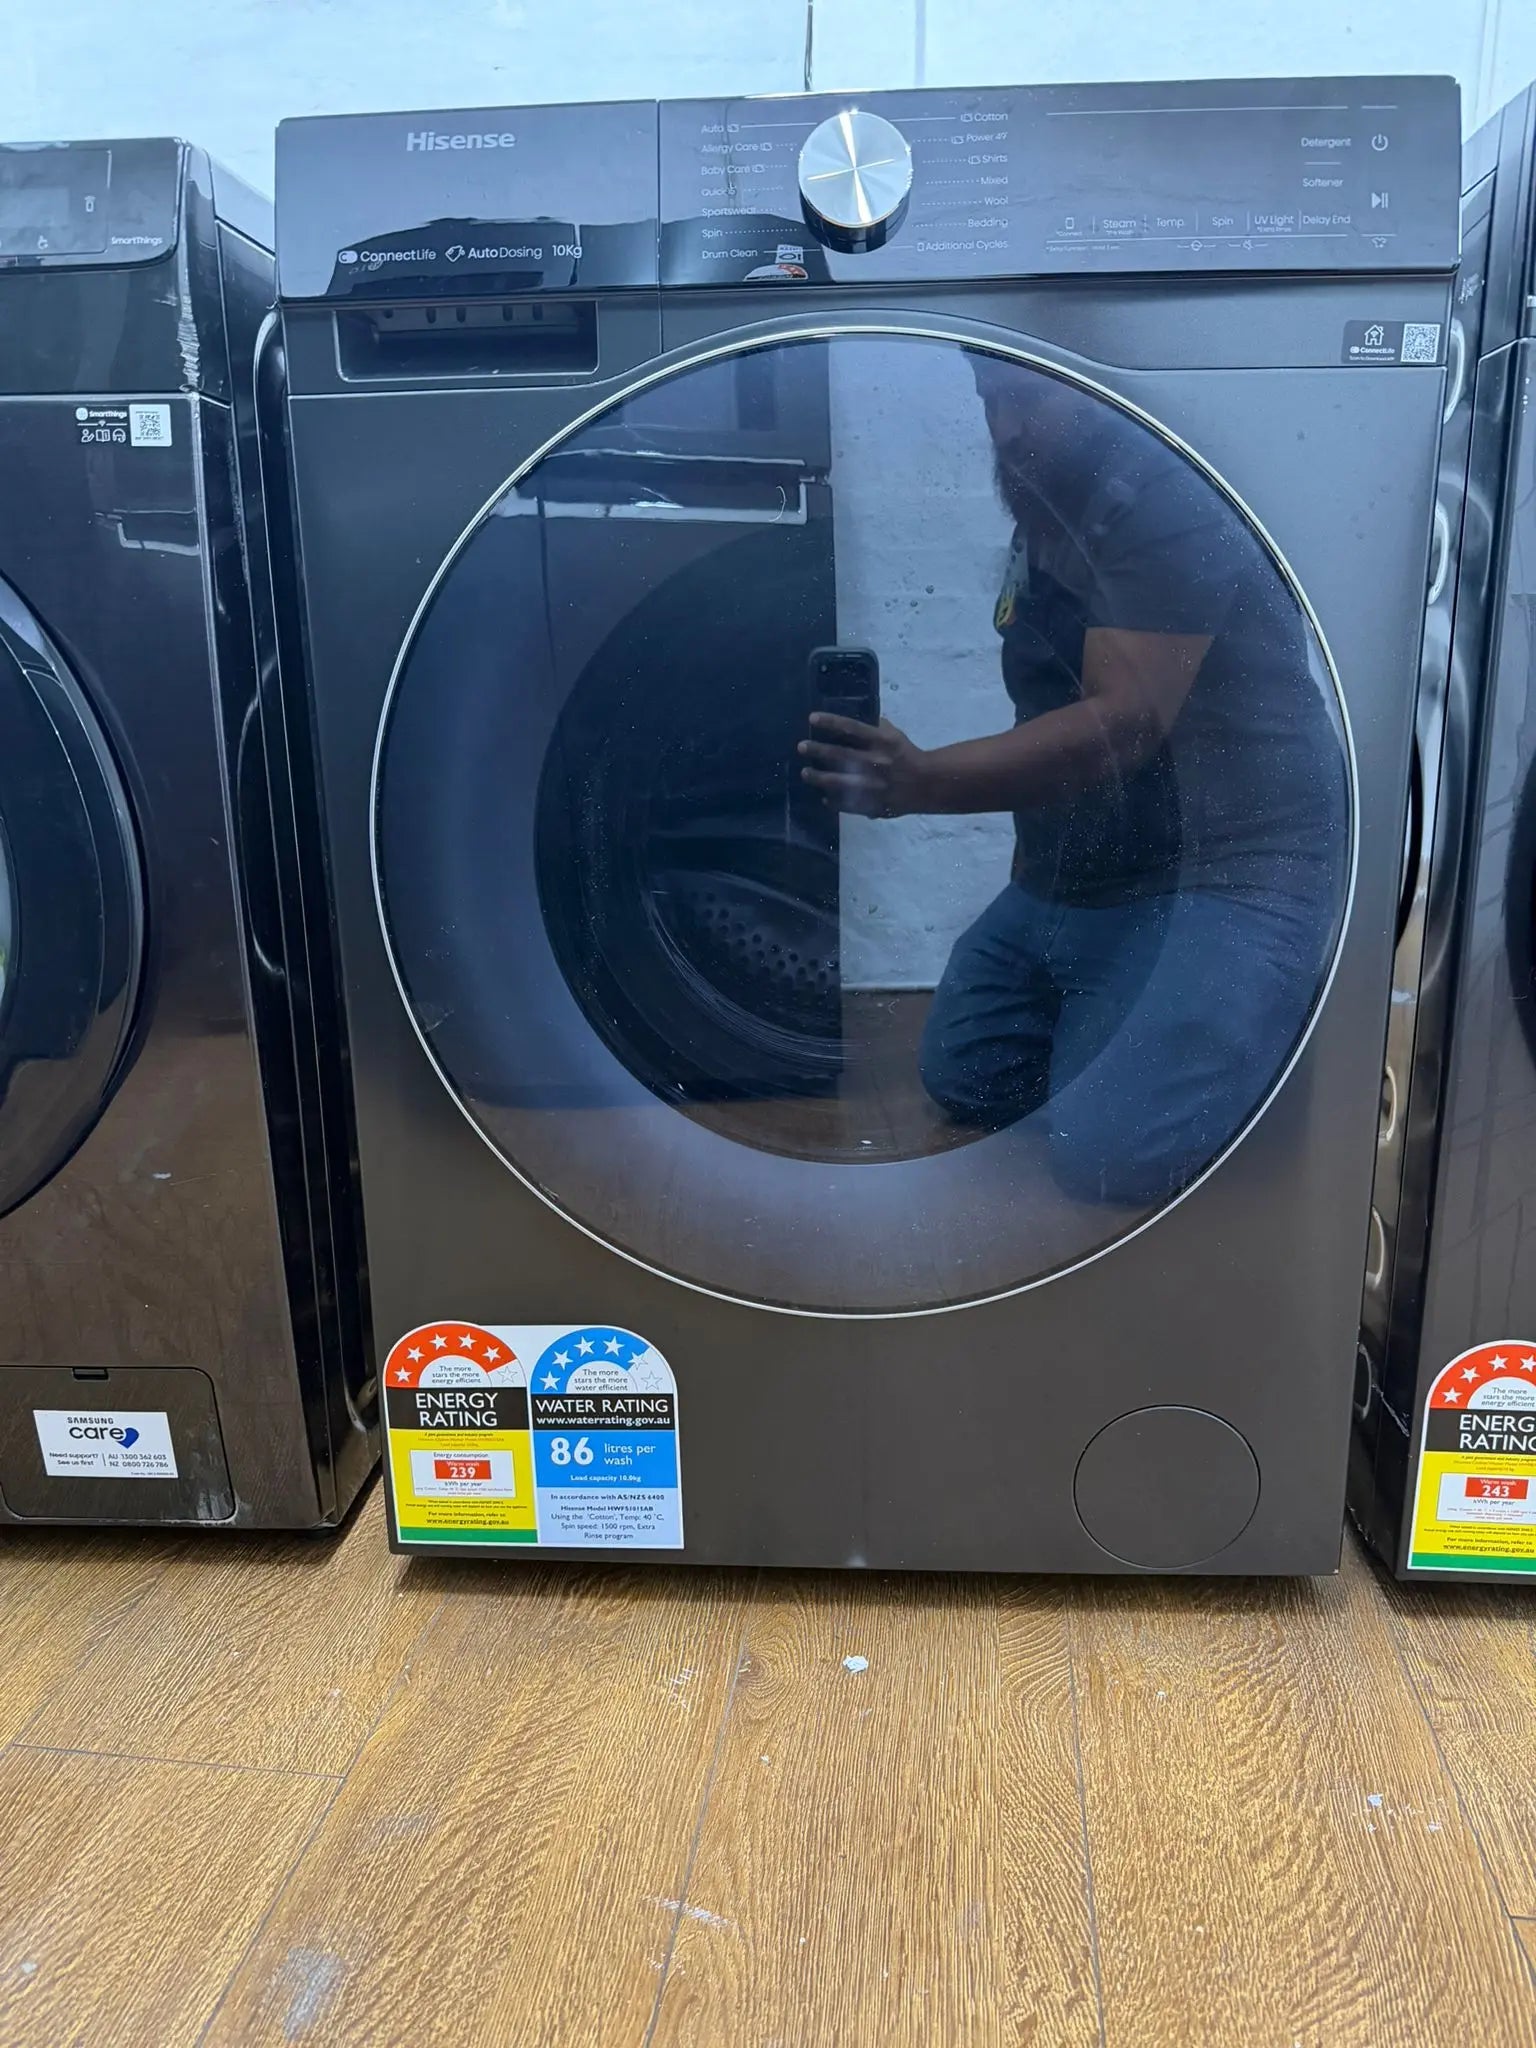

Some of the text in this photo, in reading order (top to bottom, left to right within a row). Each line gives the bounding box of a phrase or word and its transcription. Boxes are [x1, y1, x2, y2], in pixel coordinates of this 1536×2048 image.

[974, 112, 1008, 121] Cotton
[701, 124, 724, 133] Auto
[407, 132, 516, 151] Hisense
[966, 133, 994, 143] Power
[1301, 137, 1352, 149] Detergent
[701, 143, 759, 154] Allergy Care
[982, 154, 1008, 163] Shirts
[701, 165, 751, 176] Baby Care
[981, 176, 1008, 185] Mixed
[1302, 178, 1344, 187] Softener
[985, 196, 1008, 205] Wool
[702, 207, 757, 218] Sportswear
[968, 218, 1008, 228] Bedding
[1103, 219, 1137, 229] Steam
[1156, 217, 1185, 229] Temp
[1212, 216, 1234, 227] Spin
[1254, 215, 1294, 226] UV Light
[1303, 215, 1350, 226] Delay End
[702, 228, 723, 238] Spin
[111, 236, 163, 246] SmartThings
[926, 240, 1008, 251] Additional Cycles
[552, 244, 582, 258] 10Kg
[702, 249, 758, 259] Drum Clean
[1360, 346, 1396, 354] ConnectLife
[89, 410, 128, 419] SmartThings
[415, 1392, 499, 1409] ENERGY
[535, 1399, 669, 1413] WATER RATING
[67, 1417, 114, 1425] SAMSUNG
[419, 1411, 498, 1427] RATING
[536, 1415, 671, 1427] www.waterrating.gov.au
[1460, 1413, 1536, 1433] ENERG
[69, 1427, 124, 1440] care
[551, 1436, 656, 1466] 86 litres per
[604, 1455, 633, 1465] wash
[450, 1467, 476, 1478] 239
[589, 1475, 618, 1483] capacity
[1482, 1485, 1509, 1497] 243
[551, 1513, 570, 1521] Using
[1443, 1544, 1535, 1553] www.energyrating.gov.au
